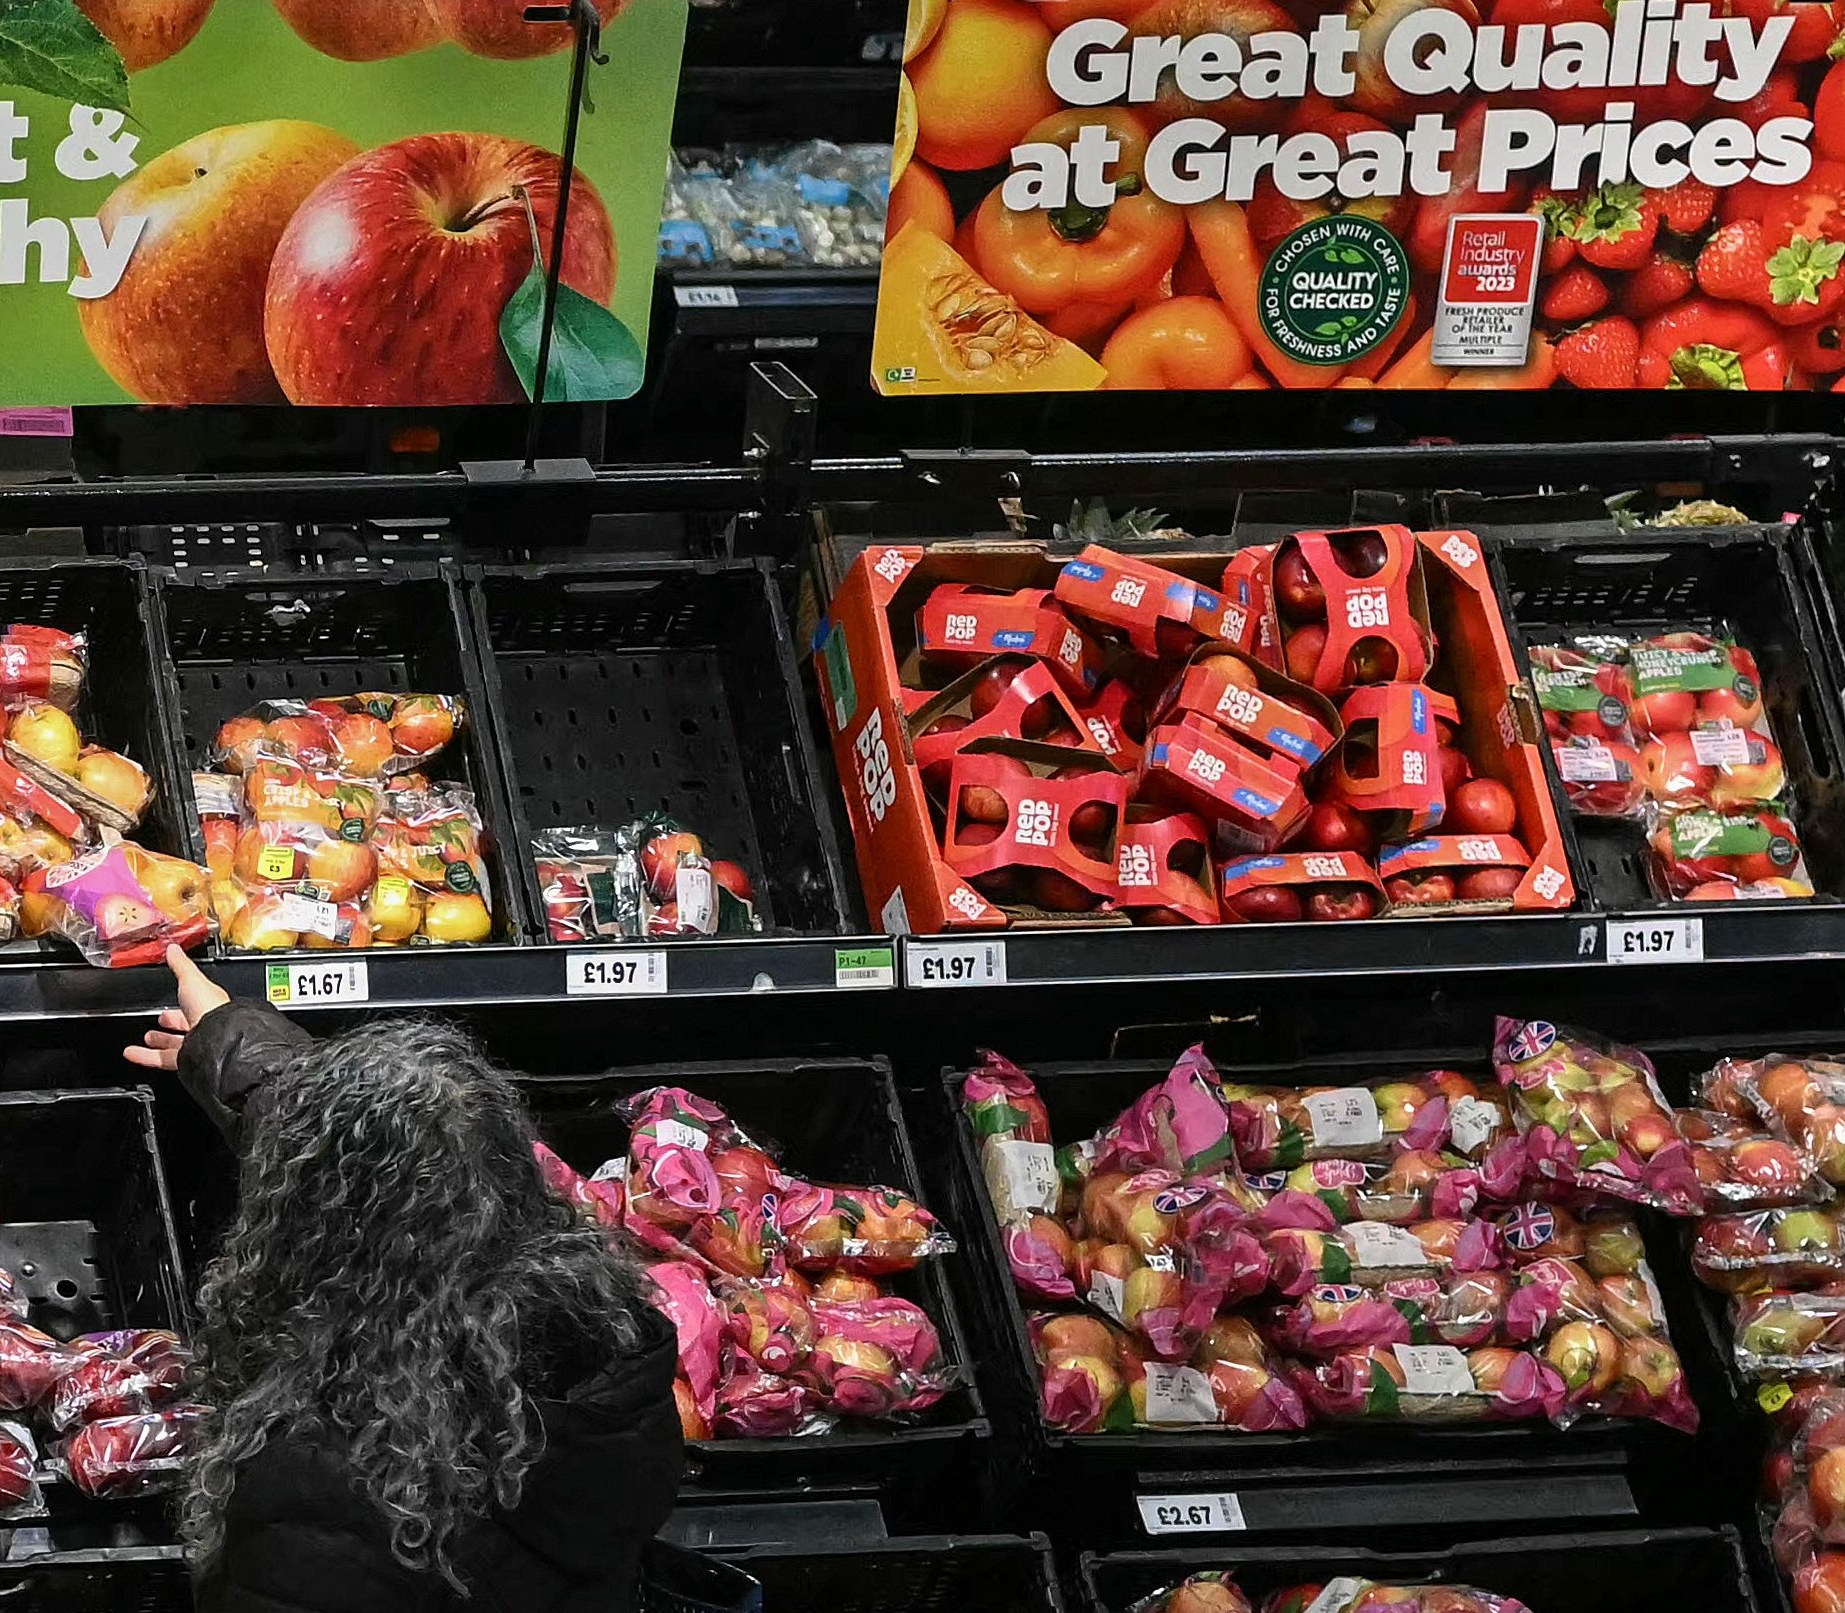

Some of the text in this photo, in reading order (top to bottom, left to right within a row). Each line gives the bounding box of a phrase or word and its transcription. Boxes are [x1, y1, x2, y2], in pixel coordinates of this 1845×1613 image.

[1046, 0, 1797, 105] Great Quality
[54, 103, 140, 181] &
[1001, 101, 1815, 212] at Great Prices
[1275, 223, 1400, 275] CHOSEN WITH CARE
[1463, 231, 1506, 246] Retail
[1460, 247, 1525, 266] Industry
[1457, 263, 1517, 276] awards
[1292, 272, 1378, 290] QUALITY
[1475, 276, 1515, 292] 2023
[1289, 293, 1374, 309] CHECKED
[1445, 307, 1525, 316] FRESH PRODUCE
[1266, 288, 1401, 358] FOR FRESHNESS AND TASTE
[1452, 325, 1513, 333] OF THE YEAR
[1463, 316, 1504, 324] RETAILER
[945, 627, 976, 639] POP
[1216, 697, 1257, 723] POP
[856, 725, 885, 821] POP
[1188, 759, 1221, 781] POP
[1032, 801, 1052, 846] POP
[1132, 844, 1151, 886] POP
[1623, 931, 1675, 952] £1.97
[584, 962, 637, 984] £1.97
[923, 957, 976, 980] £1.97
[298, 973, 342, 996] £1.67
[1157, 1506, 1211, 1525] £2.67
